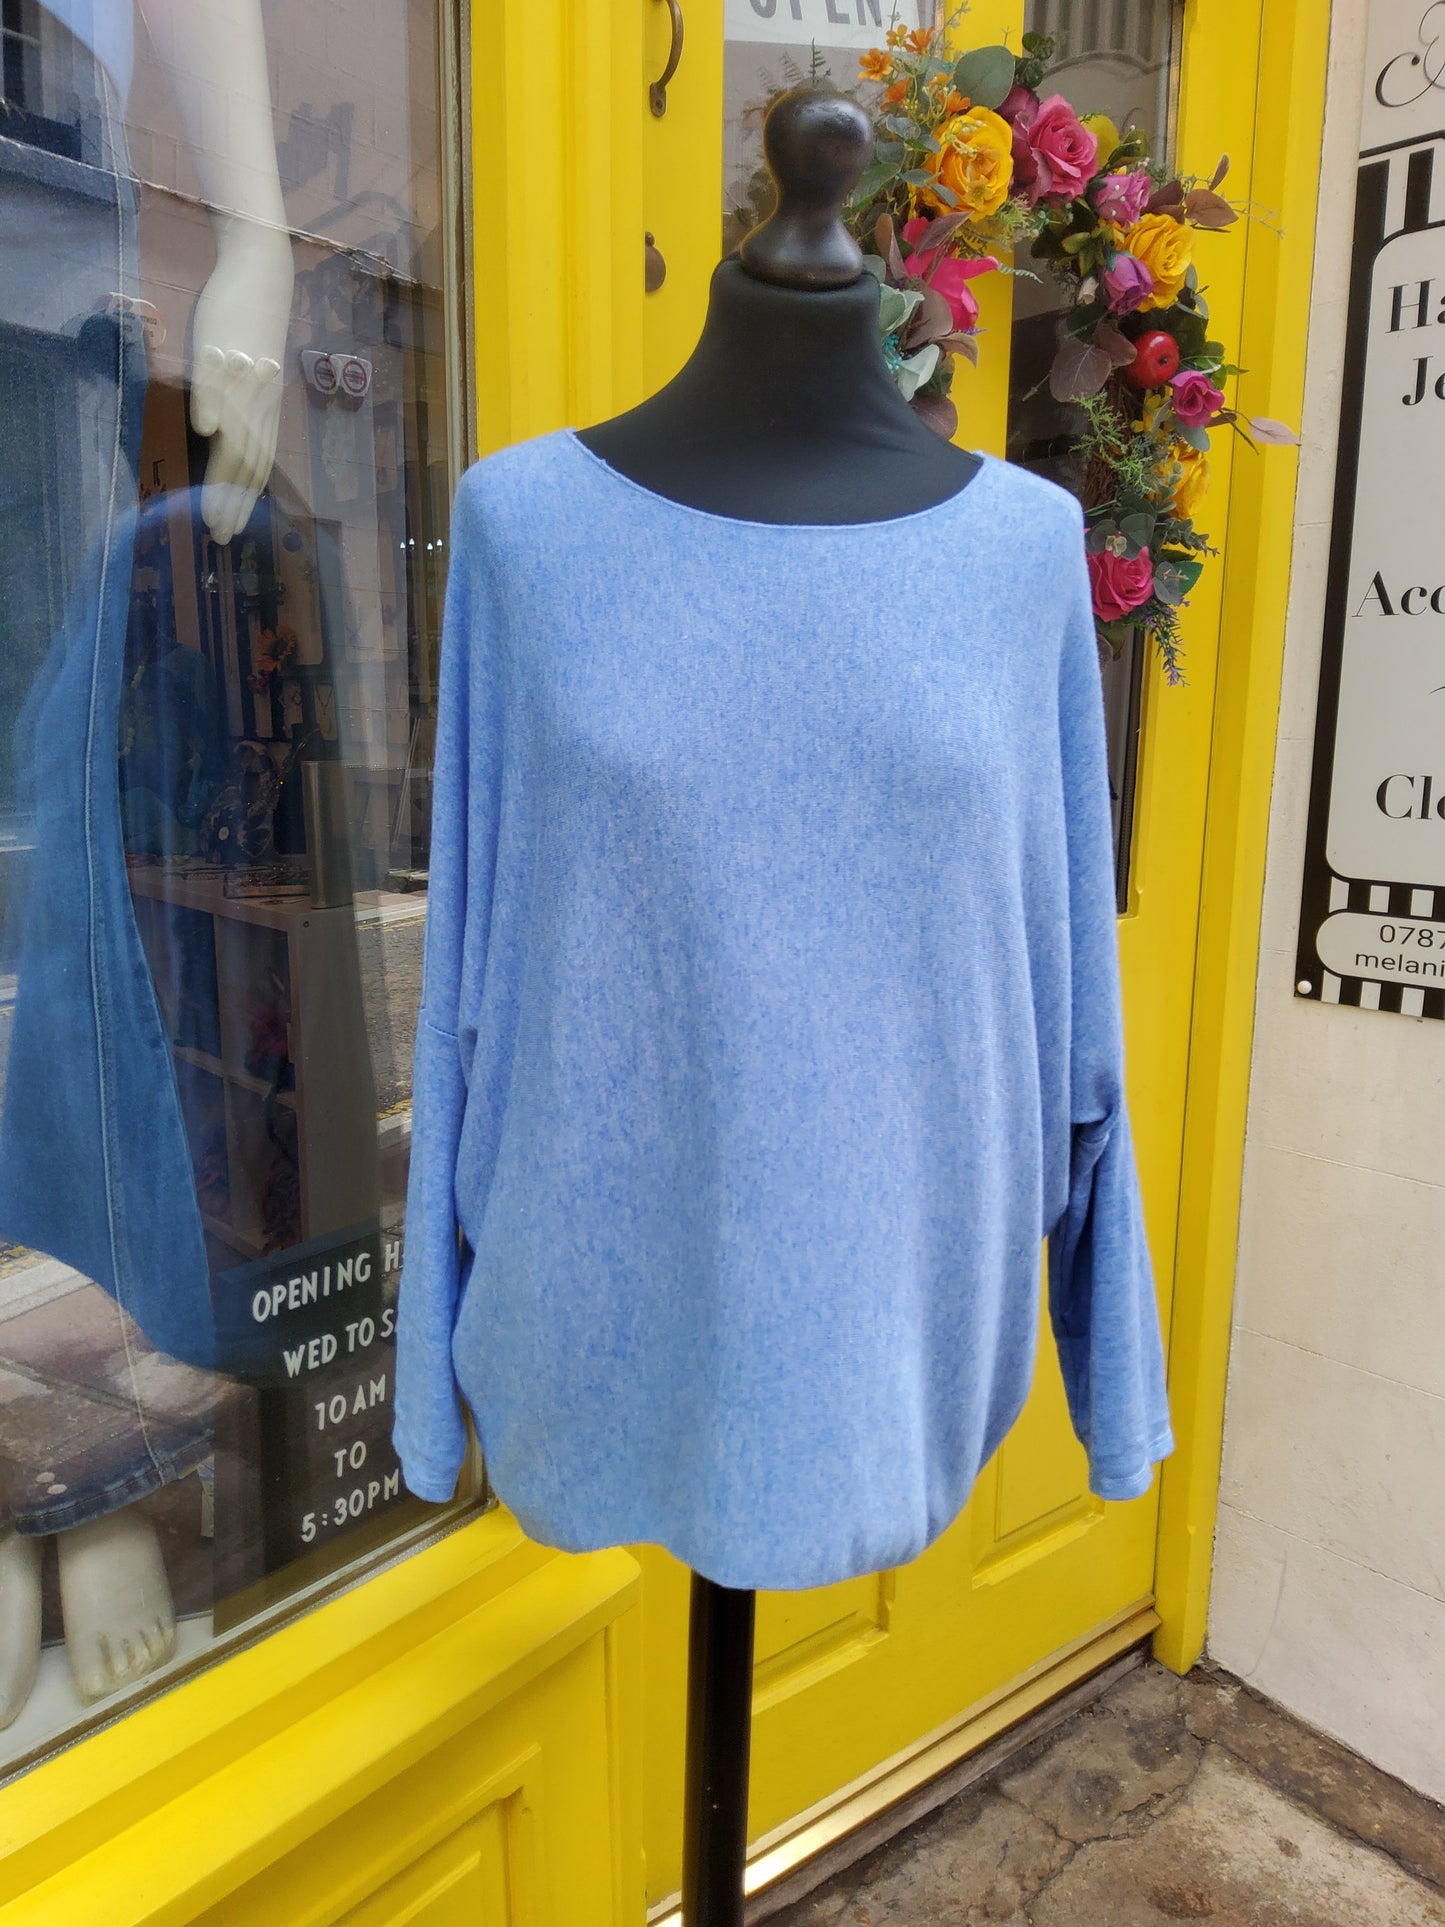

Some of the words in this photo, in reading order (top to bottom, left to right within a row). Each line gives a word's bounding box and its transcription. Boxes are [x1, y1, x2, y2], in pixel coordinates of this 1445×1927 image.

[252, 1252, 371, 1323] OPENING
[384, 1241, 404, 1273] H
[283, 1333, 337, 1379] WED
[345, 1317, 375, 1352] TO
[380, 1308, 397, 1338] S
[334, 1440, 367, 1478] TO
[300, 1468, 399, 1543] 5:30PM
